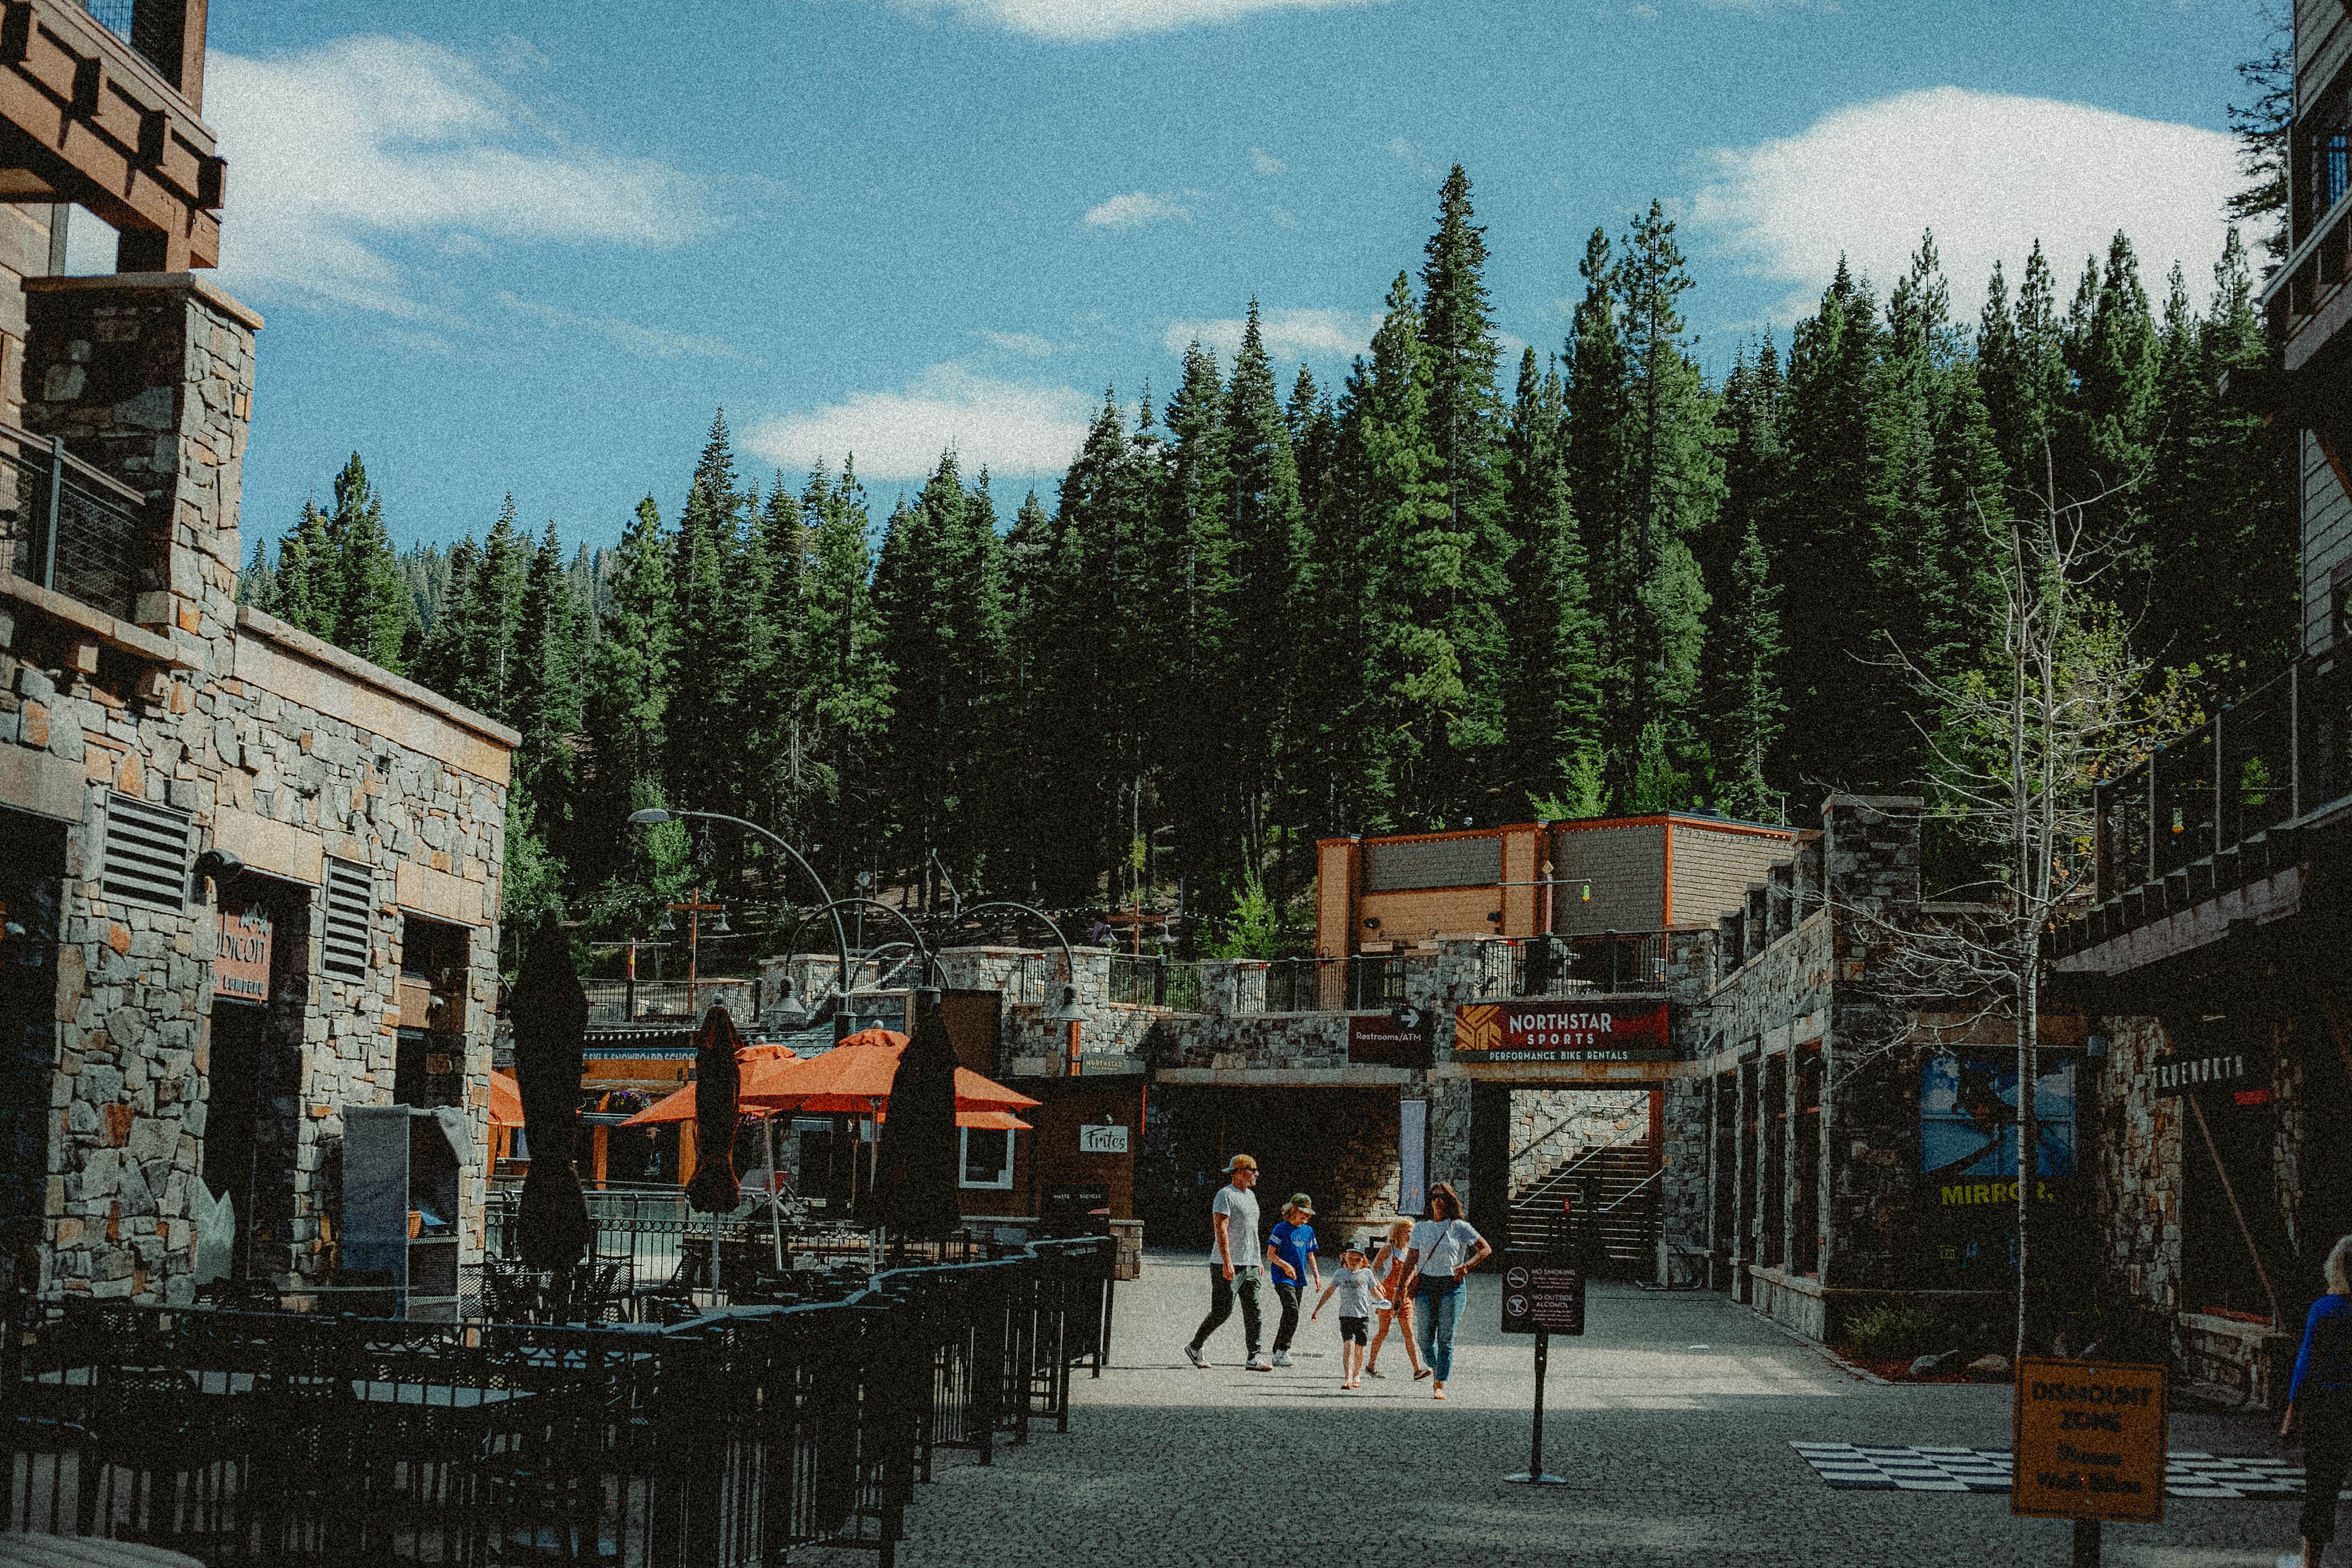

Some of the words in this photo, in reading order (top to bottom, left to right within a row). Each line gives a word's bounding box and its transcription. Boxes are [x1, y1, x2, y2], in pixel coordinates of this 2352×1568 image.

[1510, 1013, 1612, 1034] NORTHSTAR
[1356, 1032, 1421, 1042] Restrooms/ATM
[1527, 1033, 1594, 1045] SPORTS
[1490, 1051, 1555, 1061] PERFORMANCE
[1561, 1051, 1581, 1060] BIKE
[1587, 1051, 1628, 1060] RENTALS
[1082, 1128, 1125, 1150] Frites
[2032, 1381, 2152, 1406] DISMOUNT
[2060, 1410, 2122, 1432] ZONE
